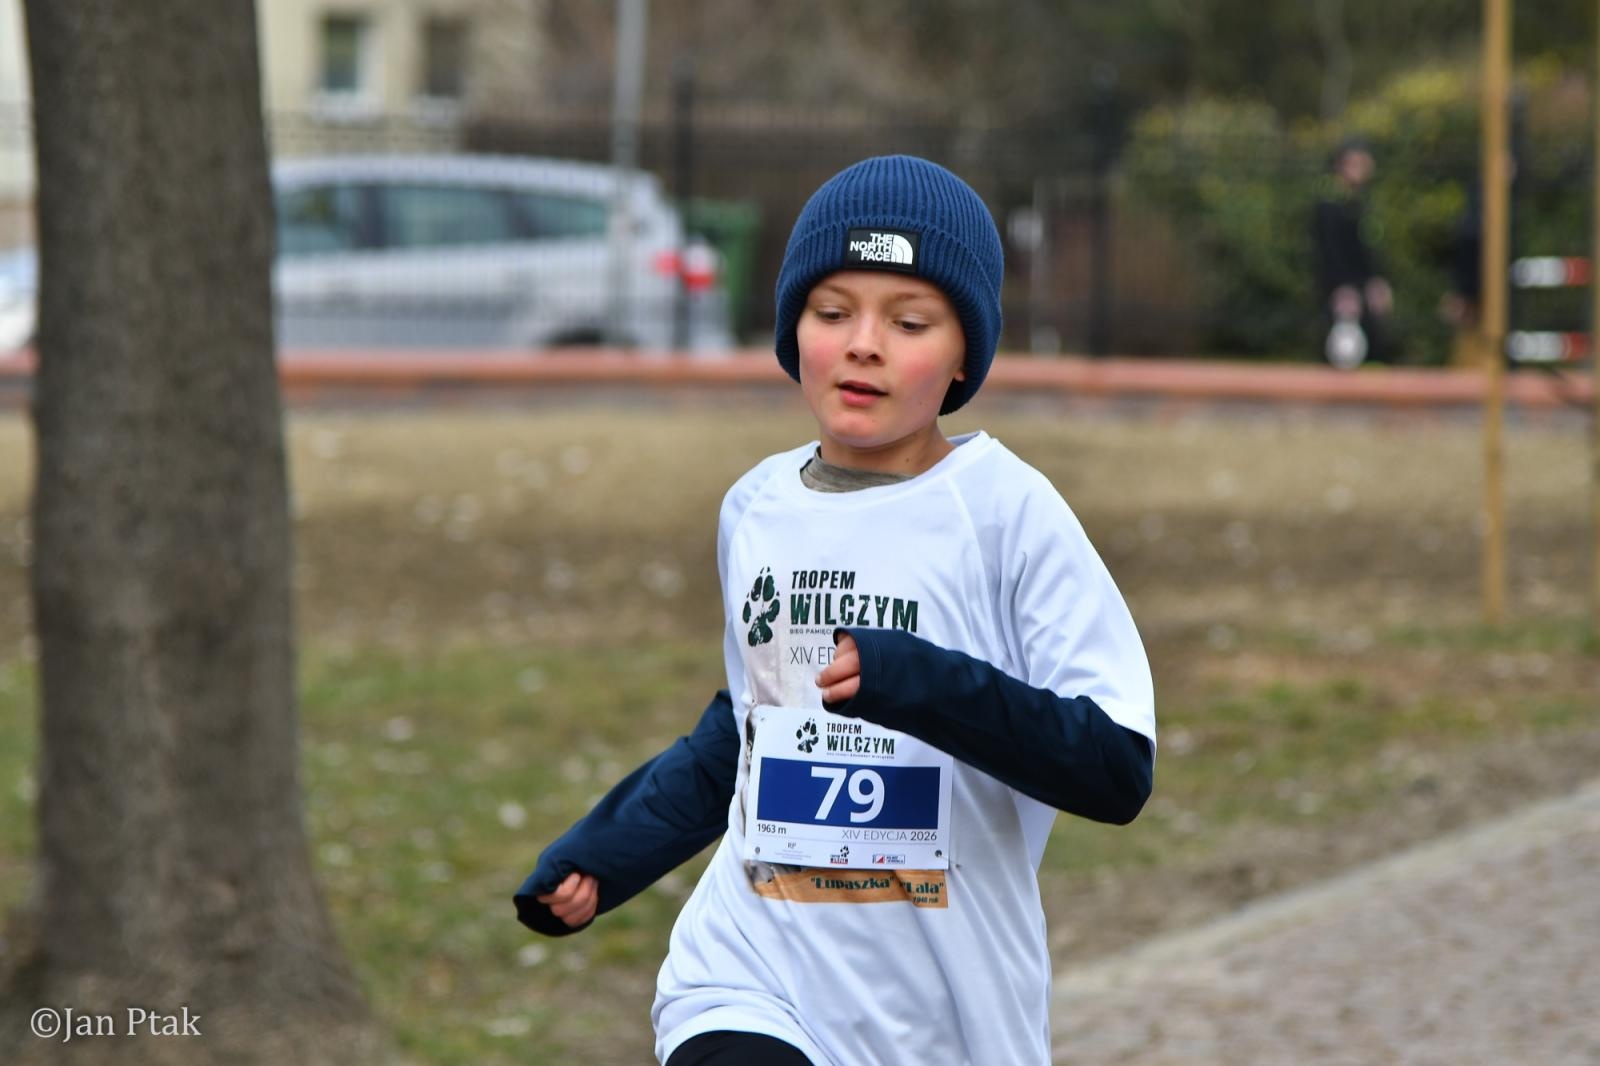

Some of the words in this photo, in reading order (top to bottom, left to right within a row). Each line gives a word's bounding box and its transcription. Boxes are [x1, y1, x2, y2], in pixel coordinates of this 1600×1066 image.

[870, 233, 894, 244] THE
[849, 240, 892, 252] NORTH
[860, 250, 891, 262] FACE
[791, 570, 856, 590] TROPEM
[790, 593, 919, 633] WILCZYM
[790, 646, 814, 665] XIV
[826, 722, 862, 735] TROPEM
[826, 734, 895, 755] WILCZYM
[810, 765, 885, 823] 79
[757, 823, 777, 834] 1963
[777, 826, 787, 835] m
[841, 829, 861, 841] XIV
[863, 829, 908, 841] EDYCJA
[909, 830, 938, 842] 2026
